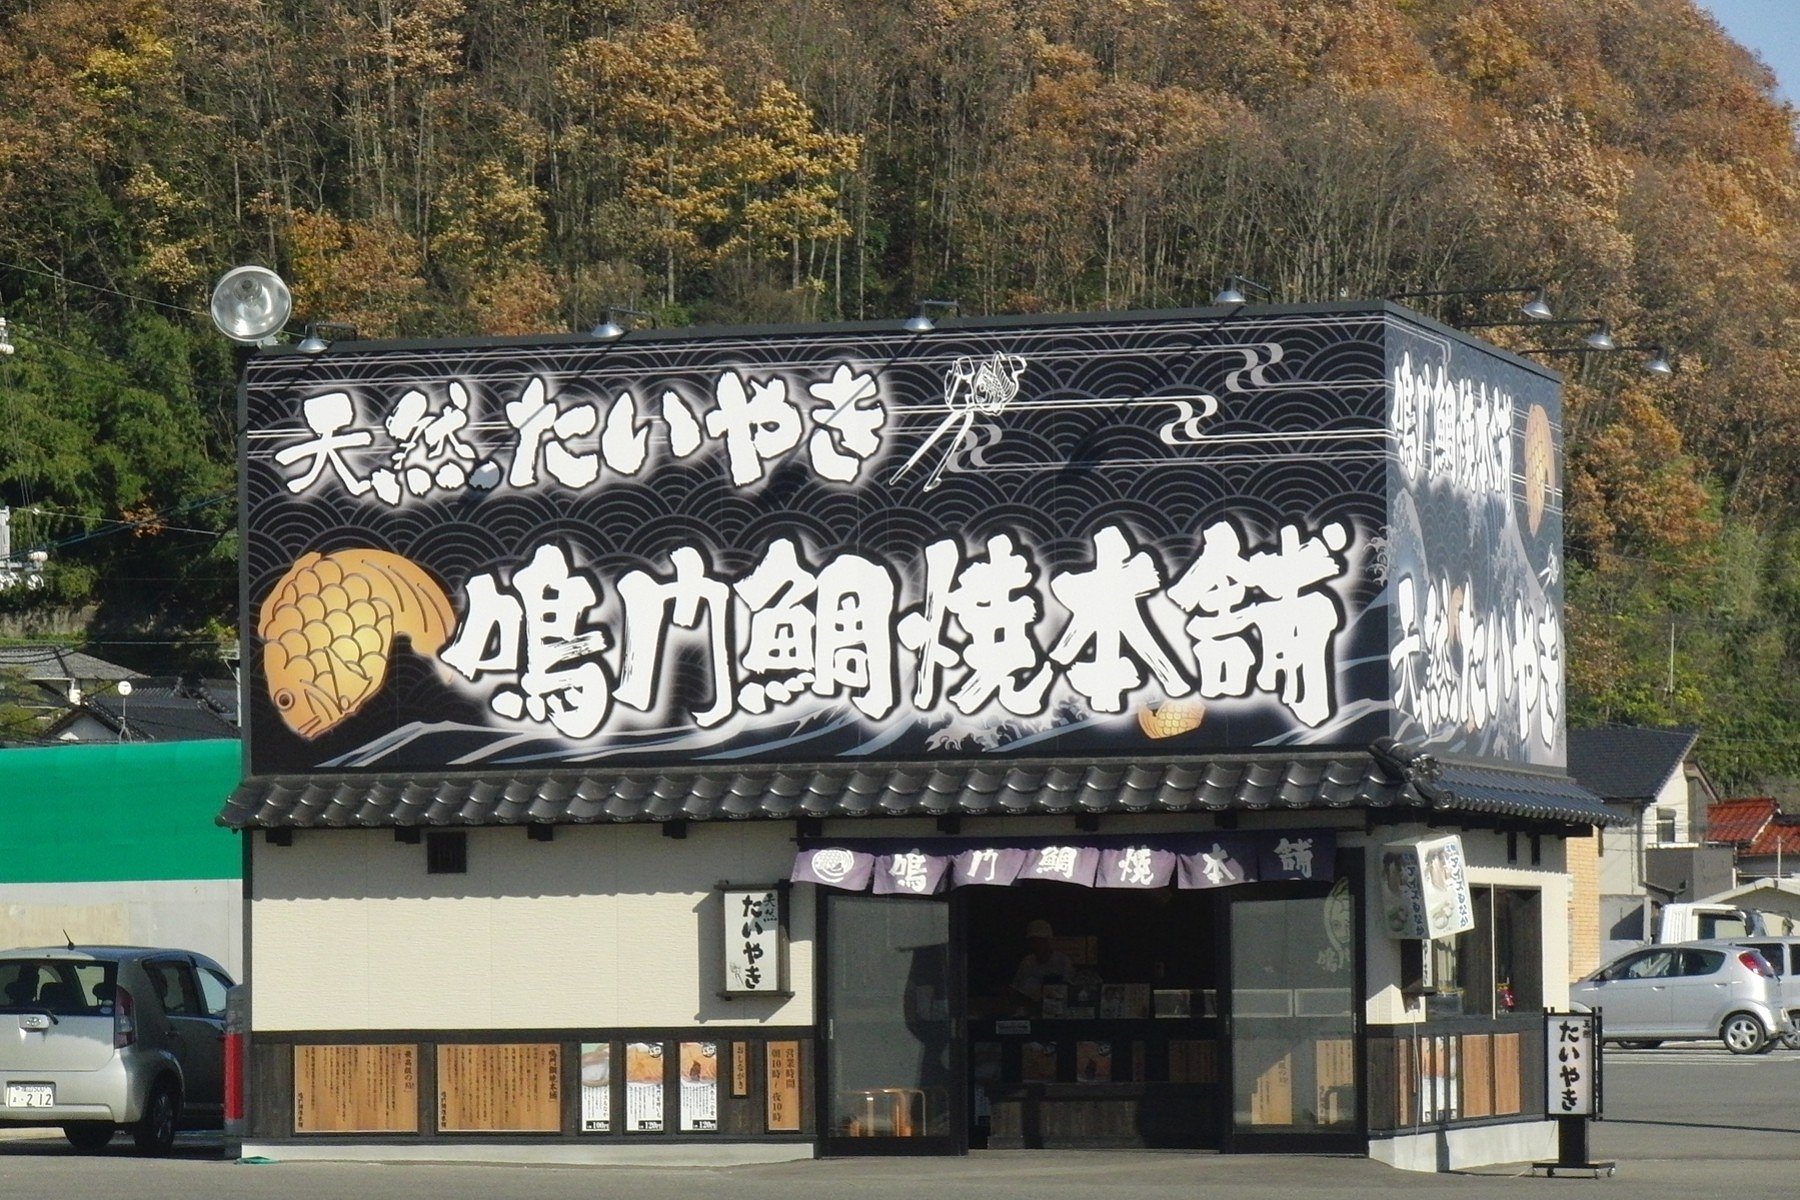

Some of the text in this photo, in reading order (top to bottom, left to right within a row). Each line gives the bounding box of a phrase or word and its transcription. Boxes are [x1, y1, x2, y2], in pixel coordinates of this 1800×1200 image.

[275, 362, 886, 505] 天然たいやき
[440, 520, 1349, 738] 鳴門鯛焼本舗
[1390, 577, 1560, 751] 天然たいやき
[890, 837, 1315, 891] 鳴門鯛焼本舗
[742, 894, 764, 990] たいやき
[785, 1048, 796, 1089] 営業時間
[1559, 1020, 1580, 1112] たいやき
